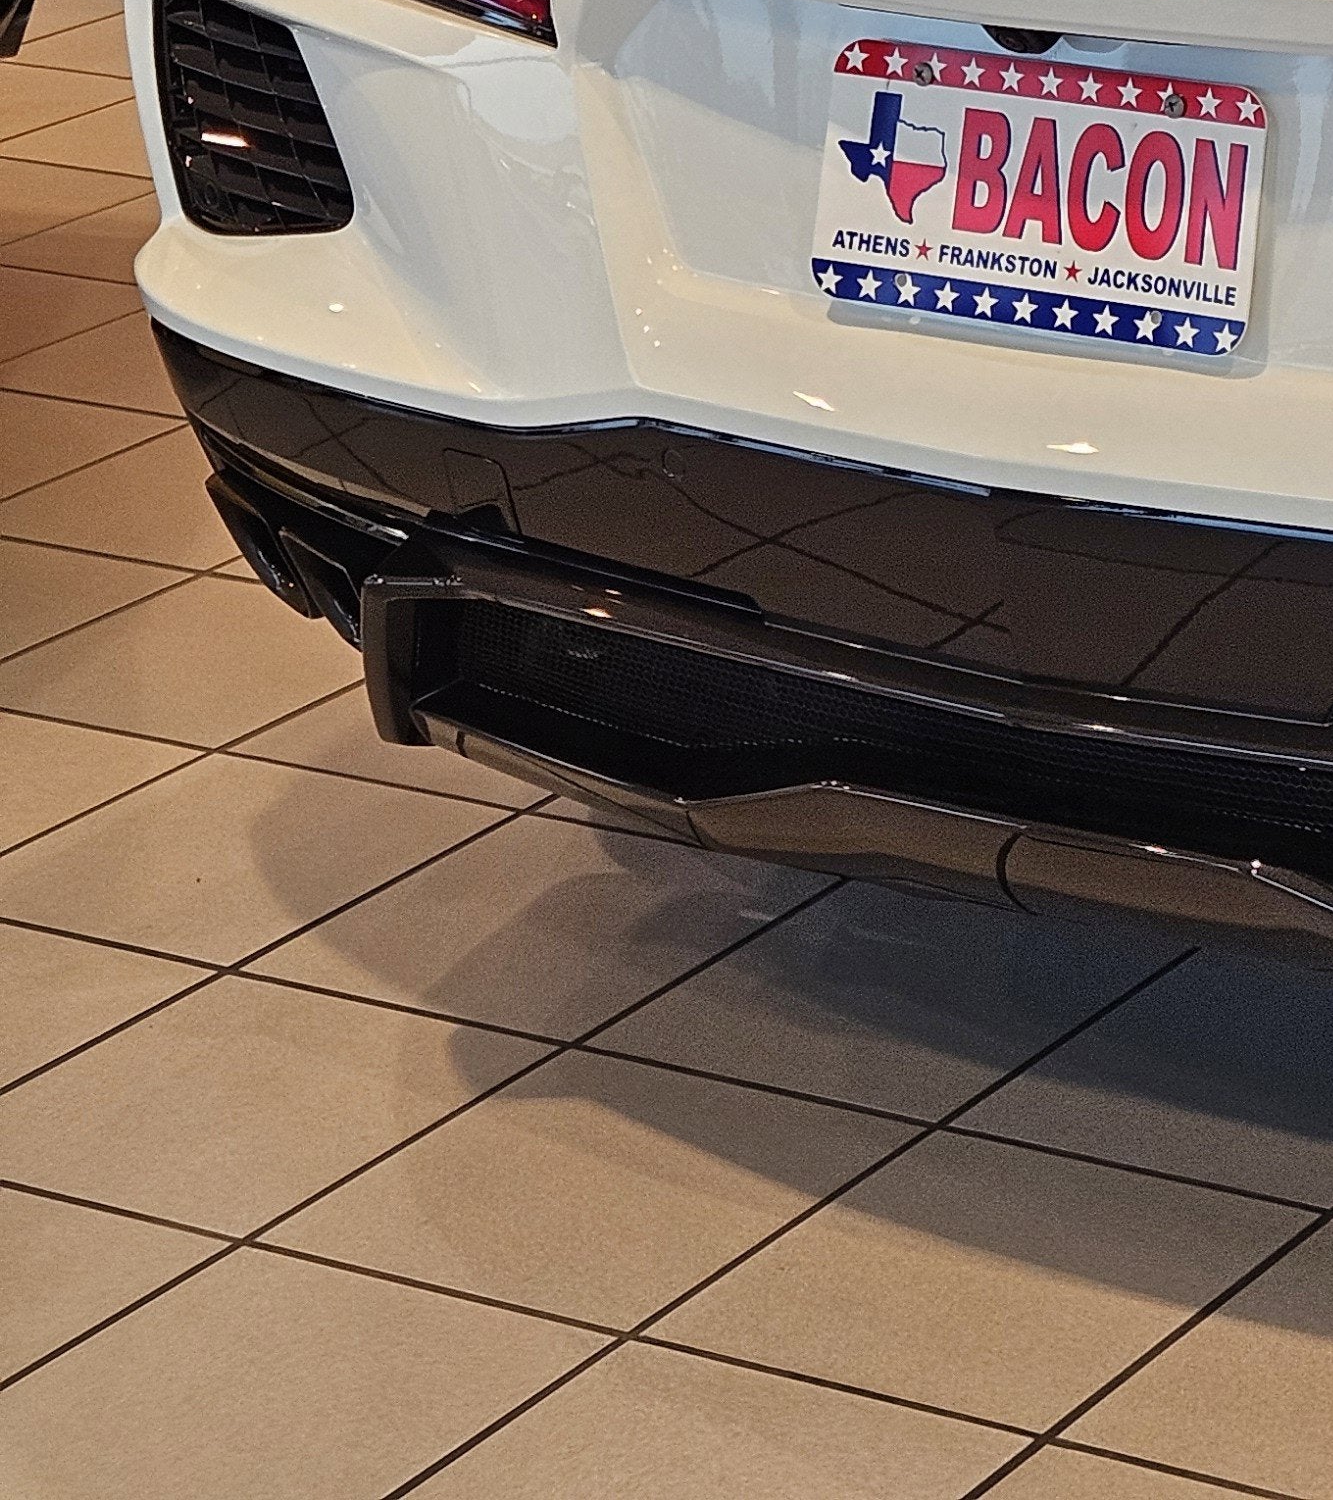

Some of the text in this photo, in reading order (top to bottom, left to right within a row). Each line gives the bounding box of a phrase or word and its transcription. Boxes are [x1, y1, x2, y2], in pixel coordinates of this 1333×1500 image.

[951, 106, 1249, 270] BACON
[832, 228, 1238, 307] ATHENS FRANKSTON JACKSONVILLE
